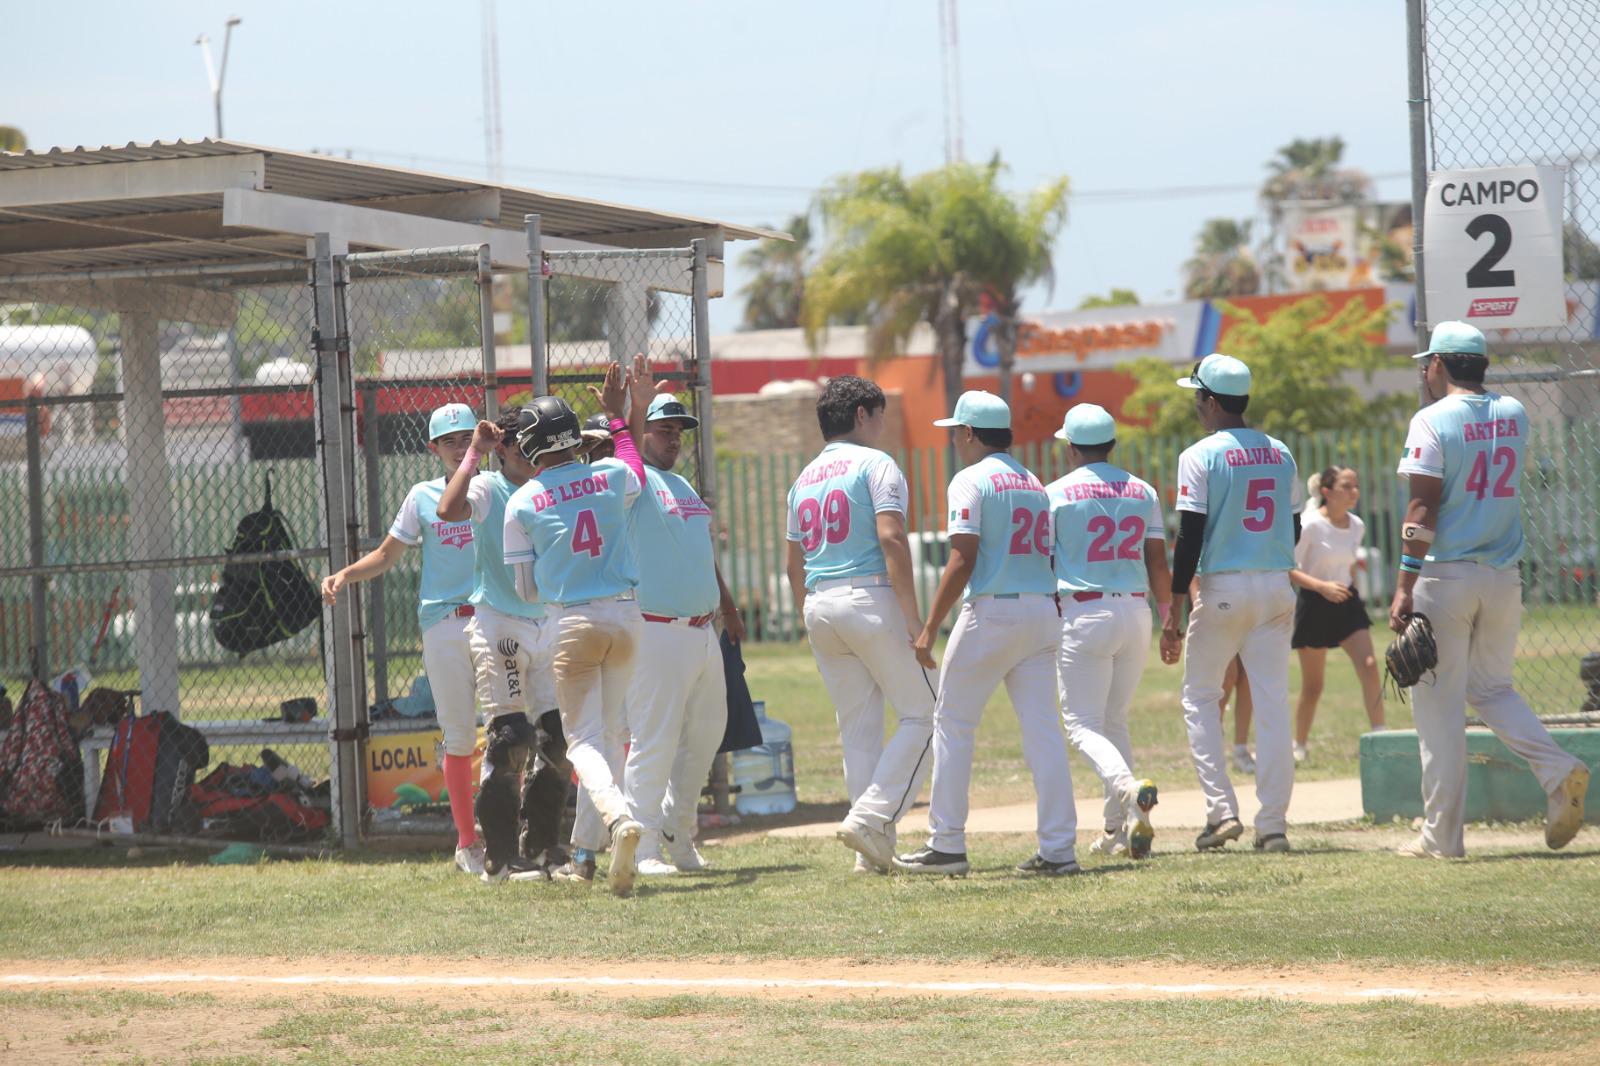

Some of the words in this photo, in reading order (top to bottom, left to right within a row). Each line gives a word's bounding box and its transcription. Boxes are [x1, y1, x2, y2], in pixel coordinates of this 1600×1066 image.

[1440, 179, 1538, 206] CAMPO
[1464, 214, 1515, 288] 2
[1225, 447, 1283, 467] GALVAN
[1465, 446, 1516, 501] 42
[531, 490, 557, 512] DE
[559, 473, 609, 501] LEON
[1063, 481, 1147, 502] FERNANDEZ
[1243, 478, 1276, 532] 5
[571, 509, 604, 560] 4
[797, 489, 850, 551] 99
[1009, 506, 1050, 557] 26
[1087, 515, 1145, 563] 22
[371, 747, 428, 772] LOCAL
